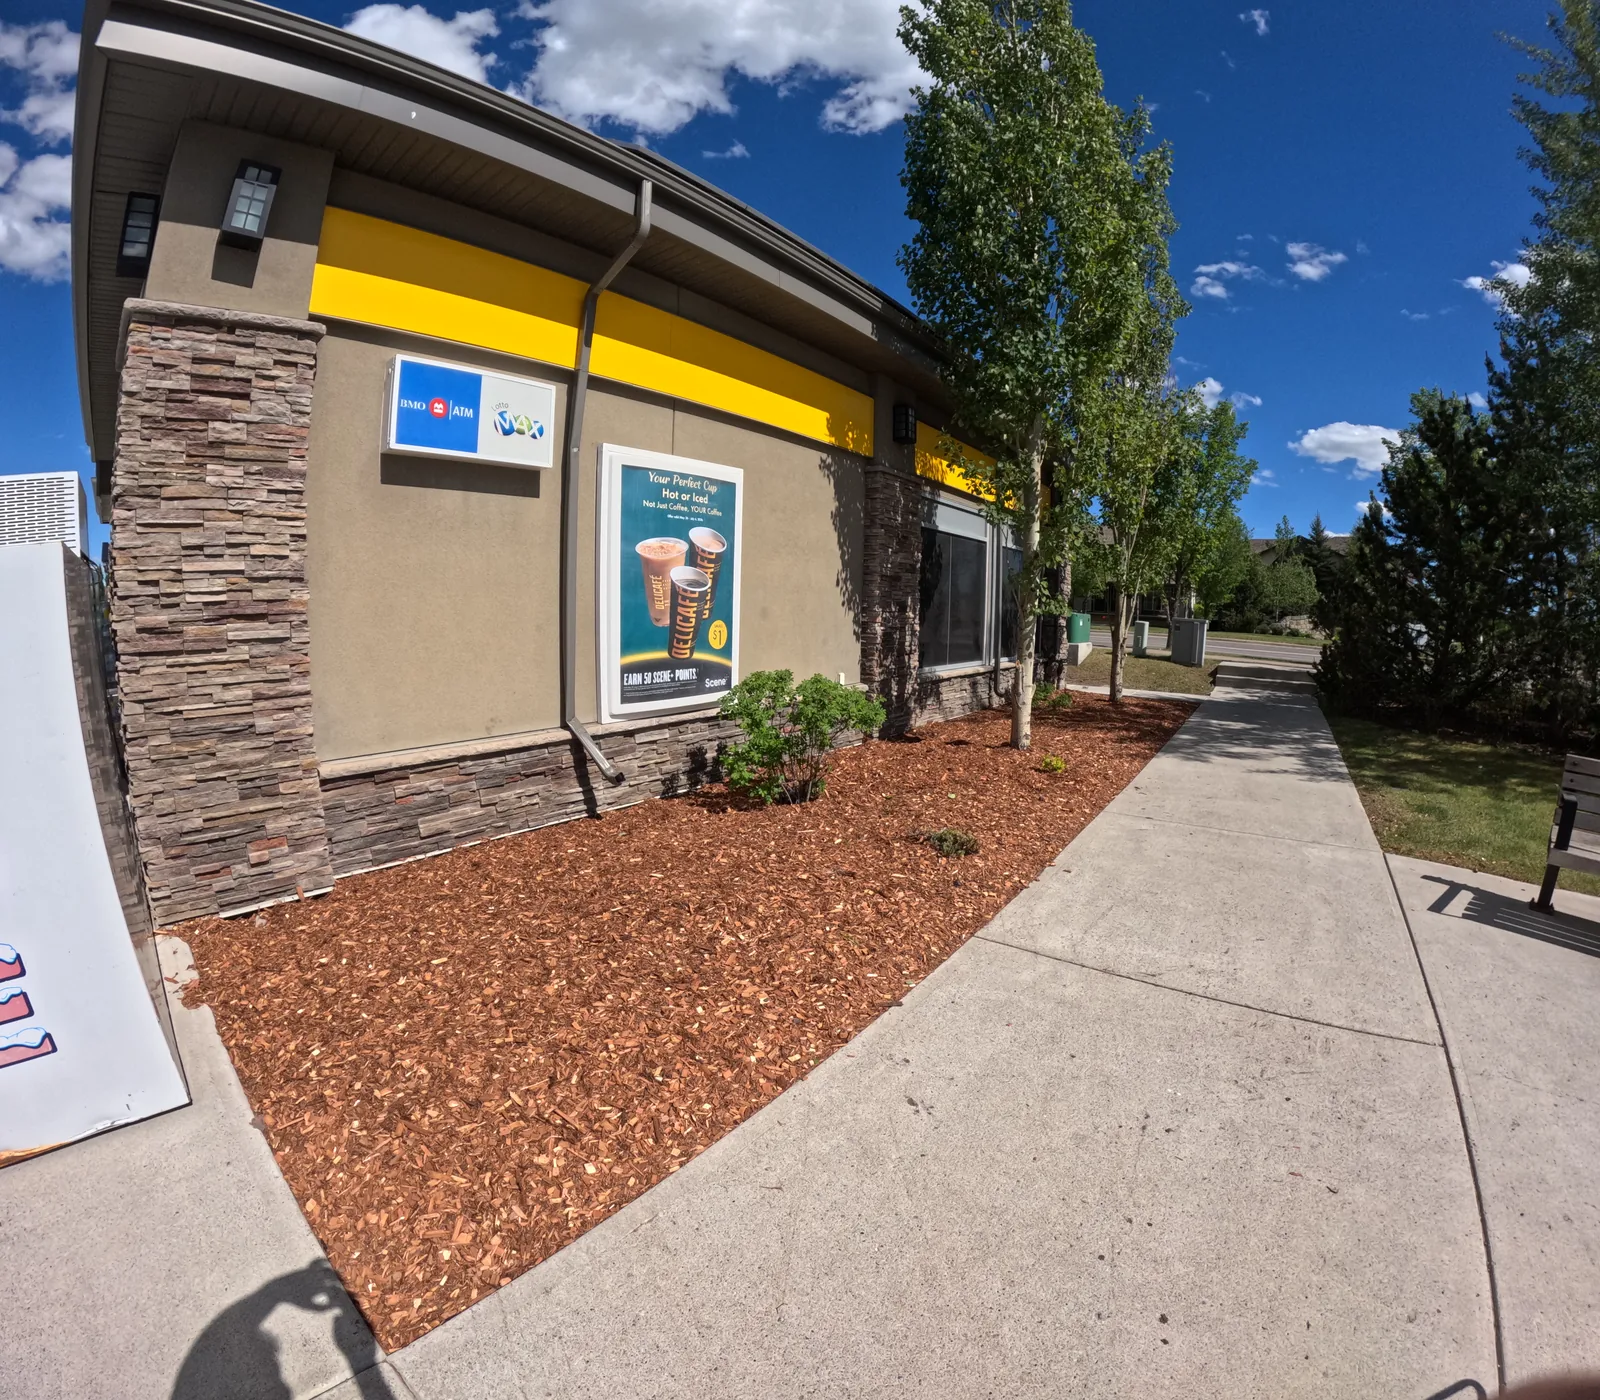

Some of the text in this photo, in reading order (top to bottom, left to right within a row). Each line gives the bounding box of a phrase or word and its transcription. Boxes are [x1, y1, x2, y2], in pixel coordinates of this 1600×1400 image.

[400, 398, 474, 419] BMO ATM
[491, 402, 509, 411] Lotto
[494, 411, 544, 440] MAX
[648, 471, 718, 495] Your Perfect Cup
[662, 488, 679, 500] Hot
[692, 492, 709, 504] Iced
[642, 500, 656, 508] Not
[656, 501, 668, 509] Just
[690, 505, 707, 514] YOUR
[707, 509, 723, 517] Coffee
[712, 630, 722, 646] $1
[623, 673, 643, 686] EARN
[643, 671, 652, 685] 50
[652, 670, 674, 683] SCENE+
